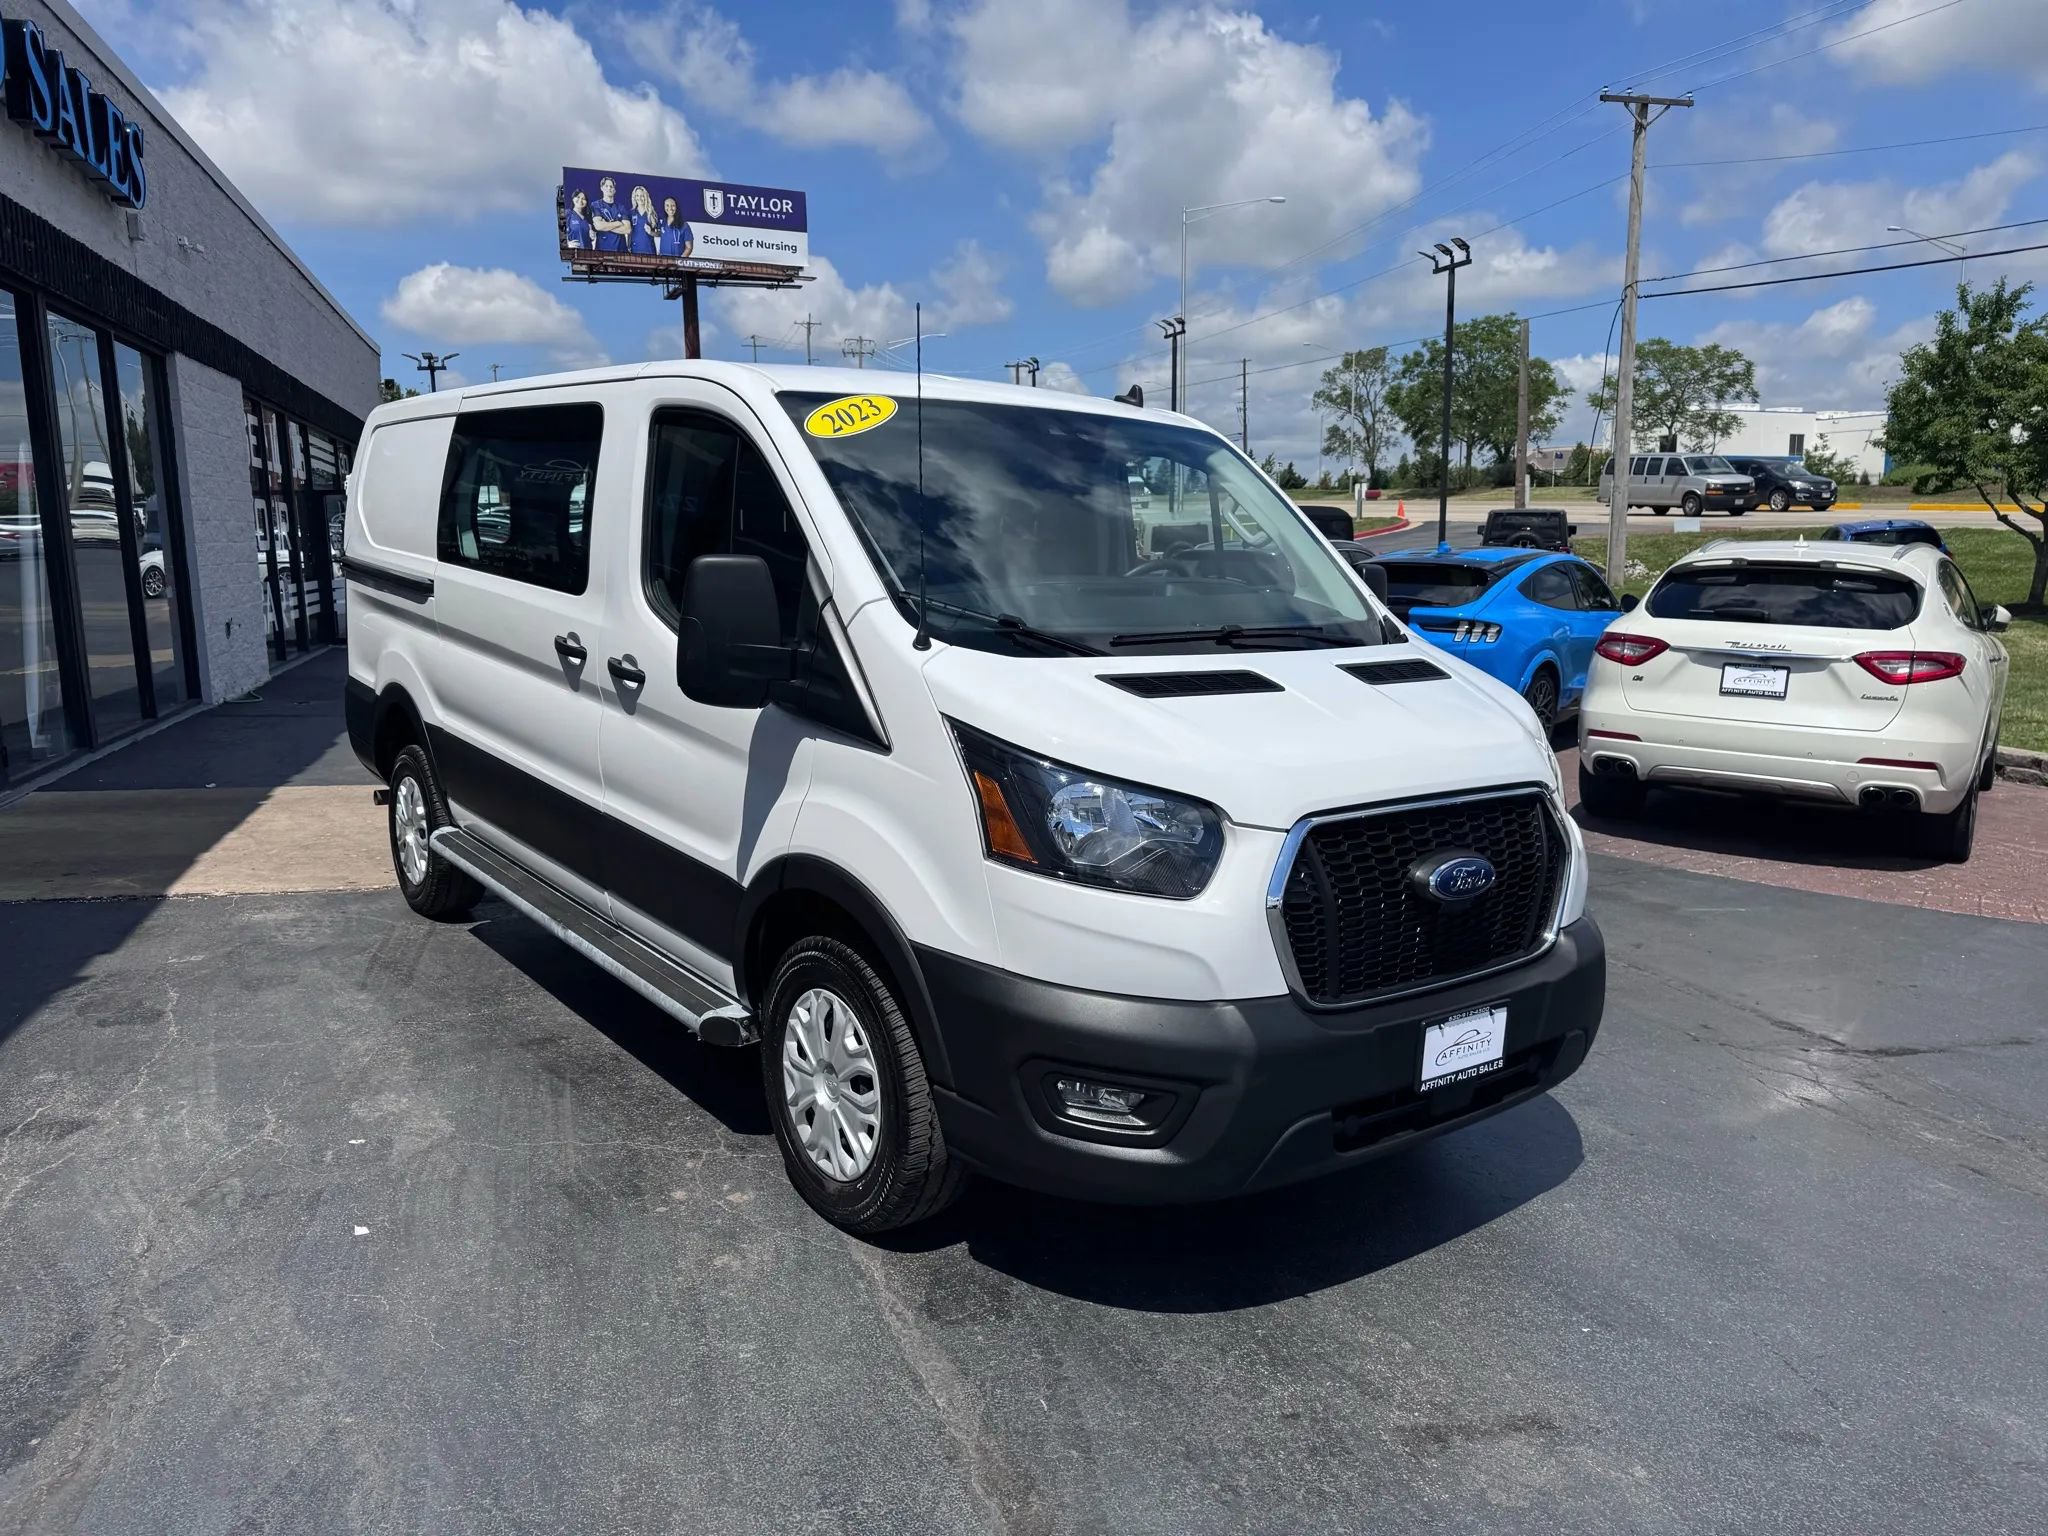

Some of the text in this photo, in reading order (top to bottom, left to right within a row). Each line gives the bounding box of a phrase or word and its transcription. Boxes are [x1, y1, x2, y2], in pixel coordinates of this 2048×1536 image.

[25, 19, 146, 210] SALES
[726, 194, 793, 213] TAYLOR
[735, 210, 786, 220] UNIVERSITY
[702, 235, 798, 254] School of Nursing
[821, 398, 881, 434] 2023
[1450, 865, 1486, 892] Ford
[1440, 1038, 1492, 1061] AFFINITY
[1420, 1059, 1504, 1093] AFFINITY AUTO SALES
